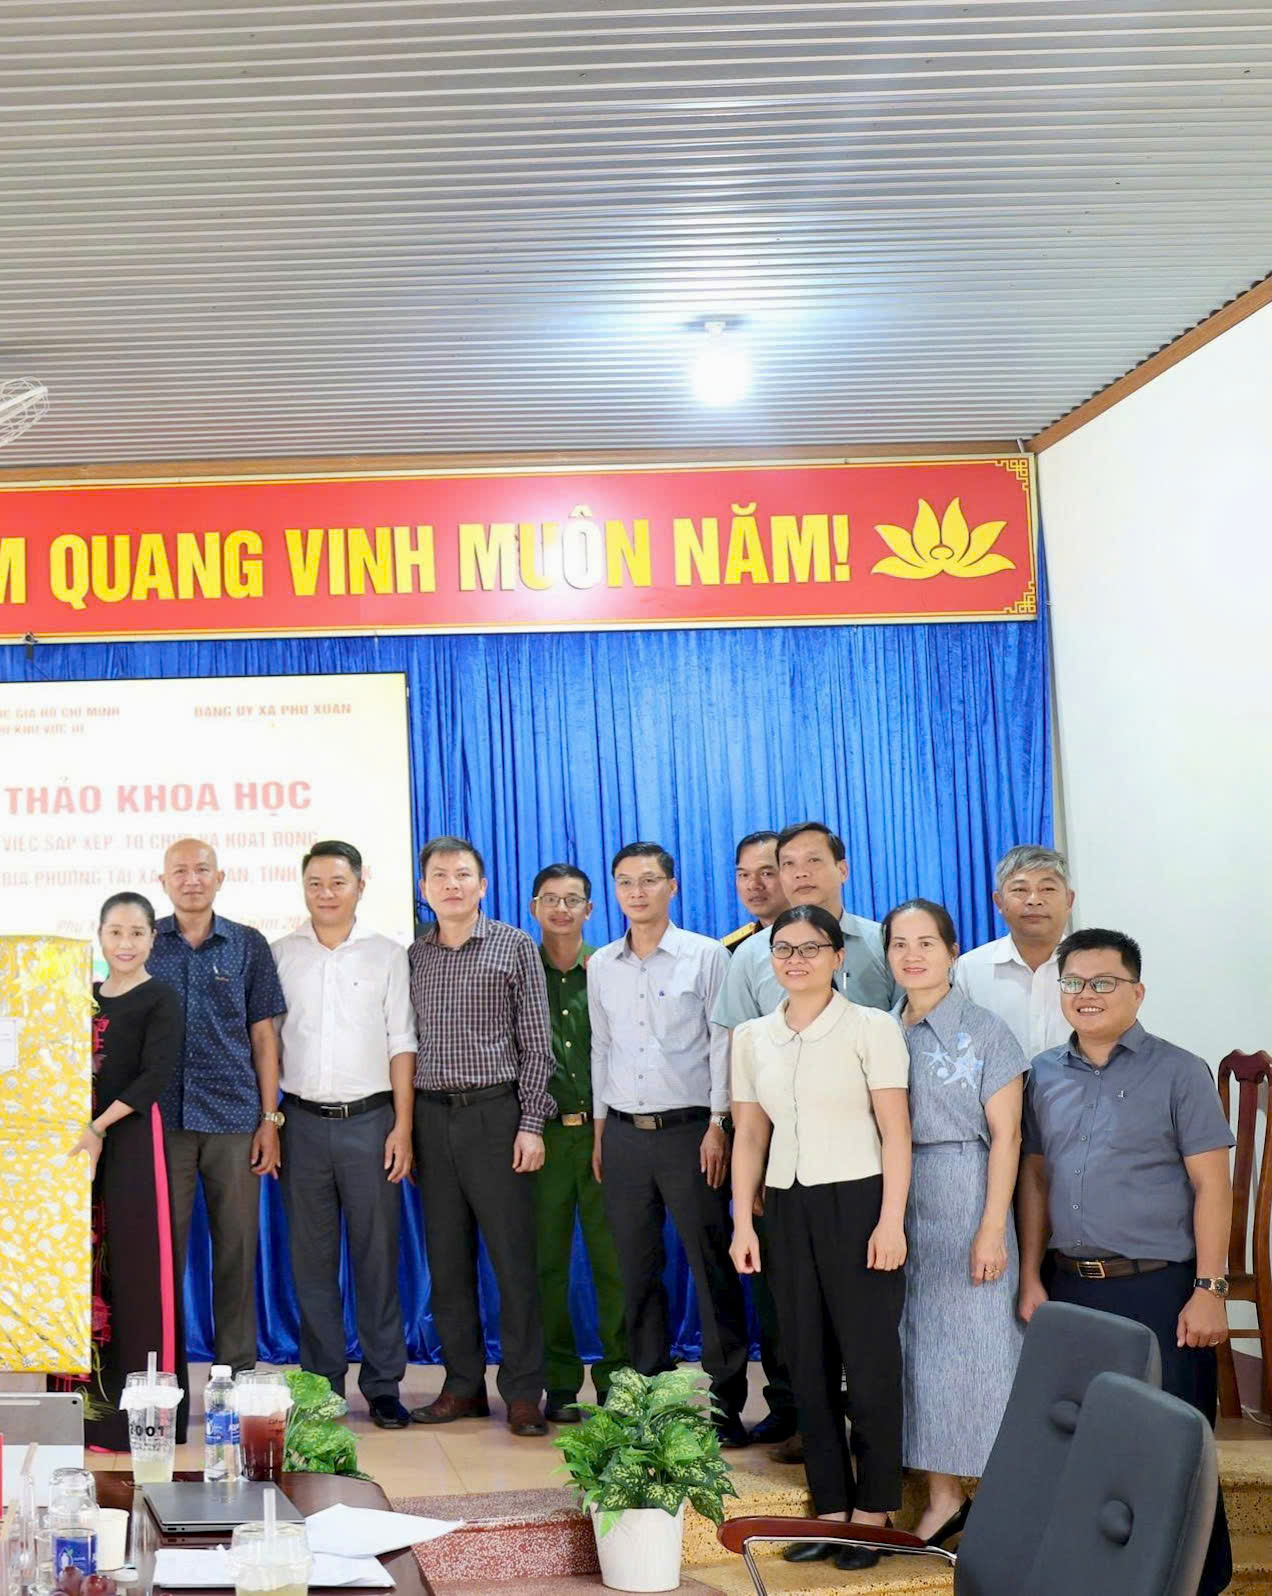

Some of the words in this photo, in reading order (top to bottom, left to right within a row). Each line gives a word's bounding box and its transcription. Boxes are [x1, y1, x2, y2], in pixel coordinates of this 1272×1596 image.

[49, 528, 264, 610] QUANG
[285, 525, 436, 597] VINH
[459, 504, 653, 592] MUÔN
[673, 502, 851, 587] NĂM!
[3, 775, 102, 816] THẢO
[115, 782, 221, 815] KHOA
[232, 780, 313, 818] HỌC
